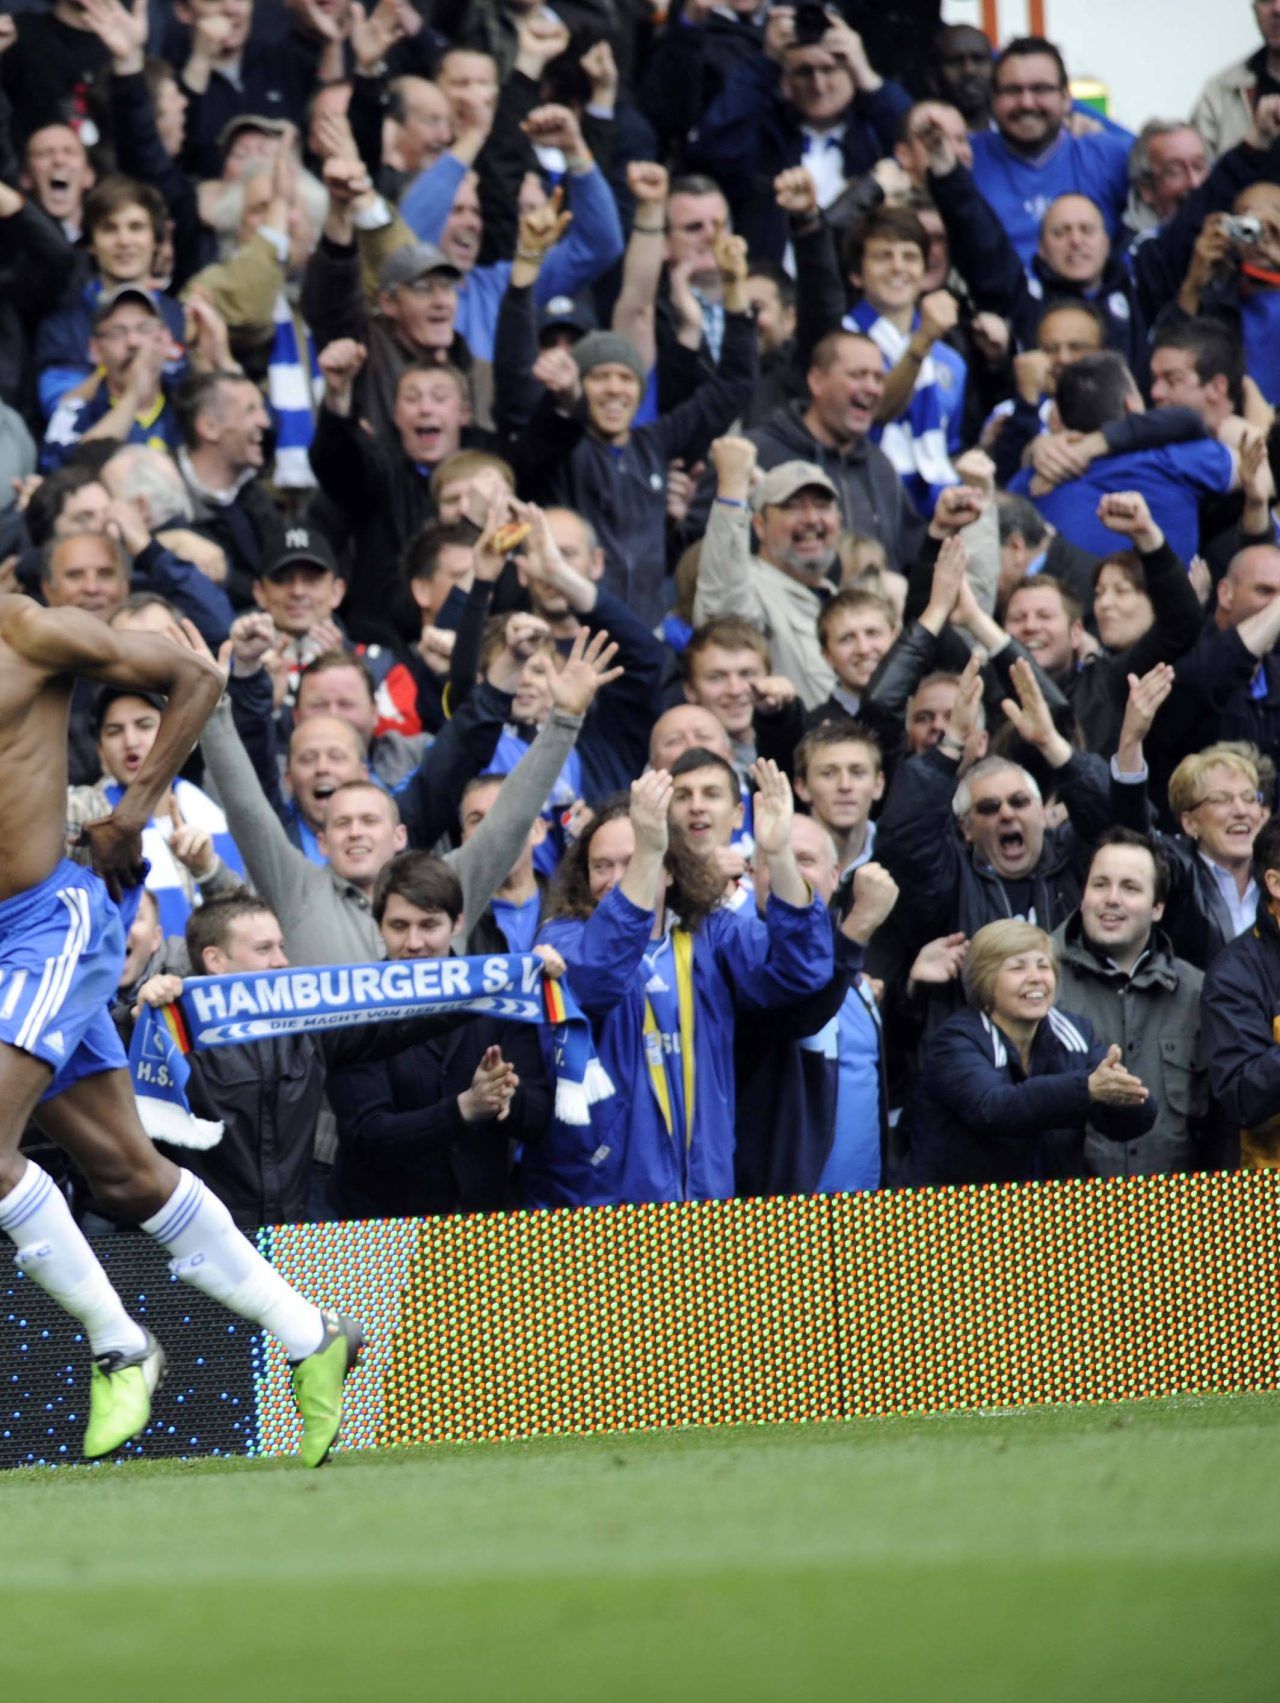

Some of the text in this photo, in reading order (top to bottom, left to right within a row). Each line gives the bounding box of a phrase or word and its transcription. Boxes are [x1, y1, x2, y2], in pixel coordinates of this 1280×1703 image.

[189, 958, 471, 1024] HAMBURGER
[270, 1019, 299, 1031] DIE
[303, 1012, 362, 1028] MACHT
[367, 1008, 401, 1020] VON
